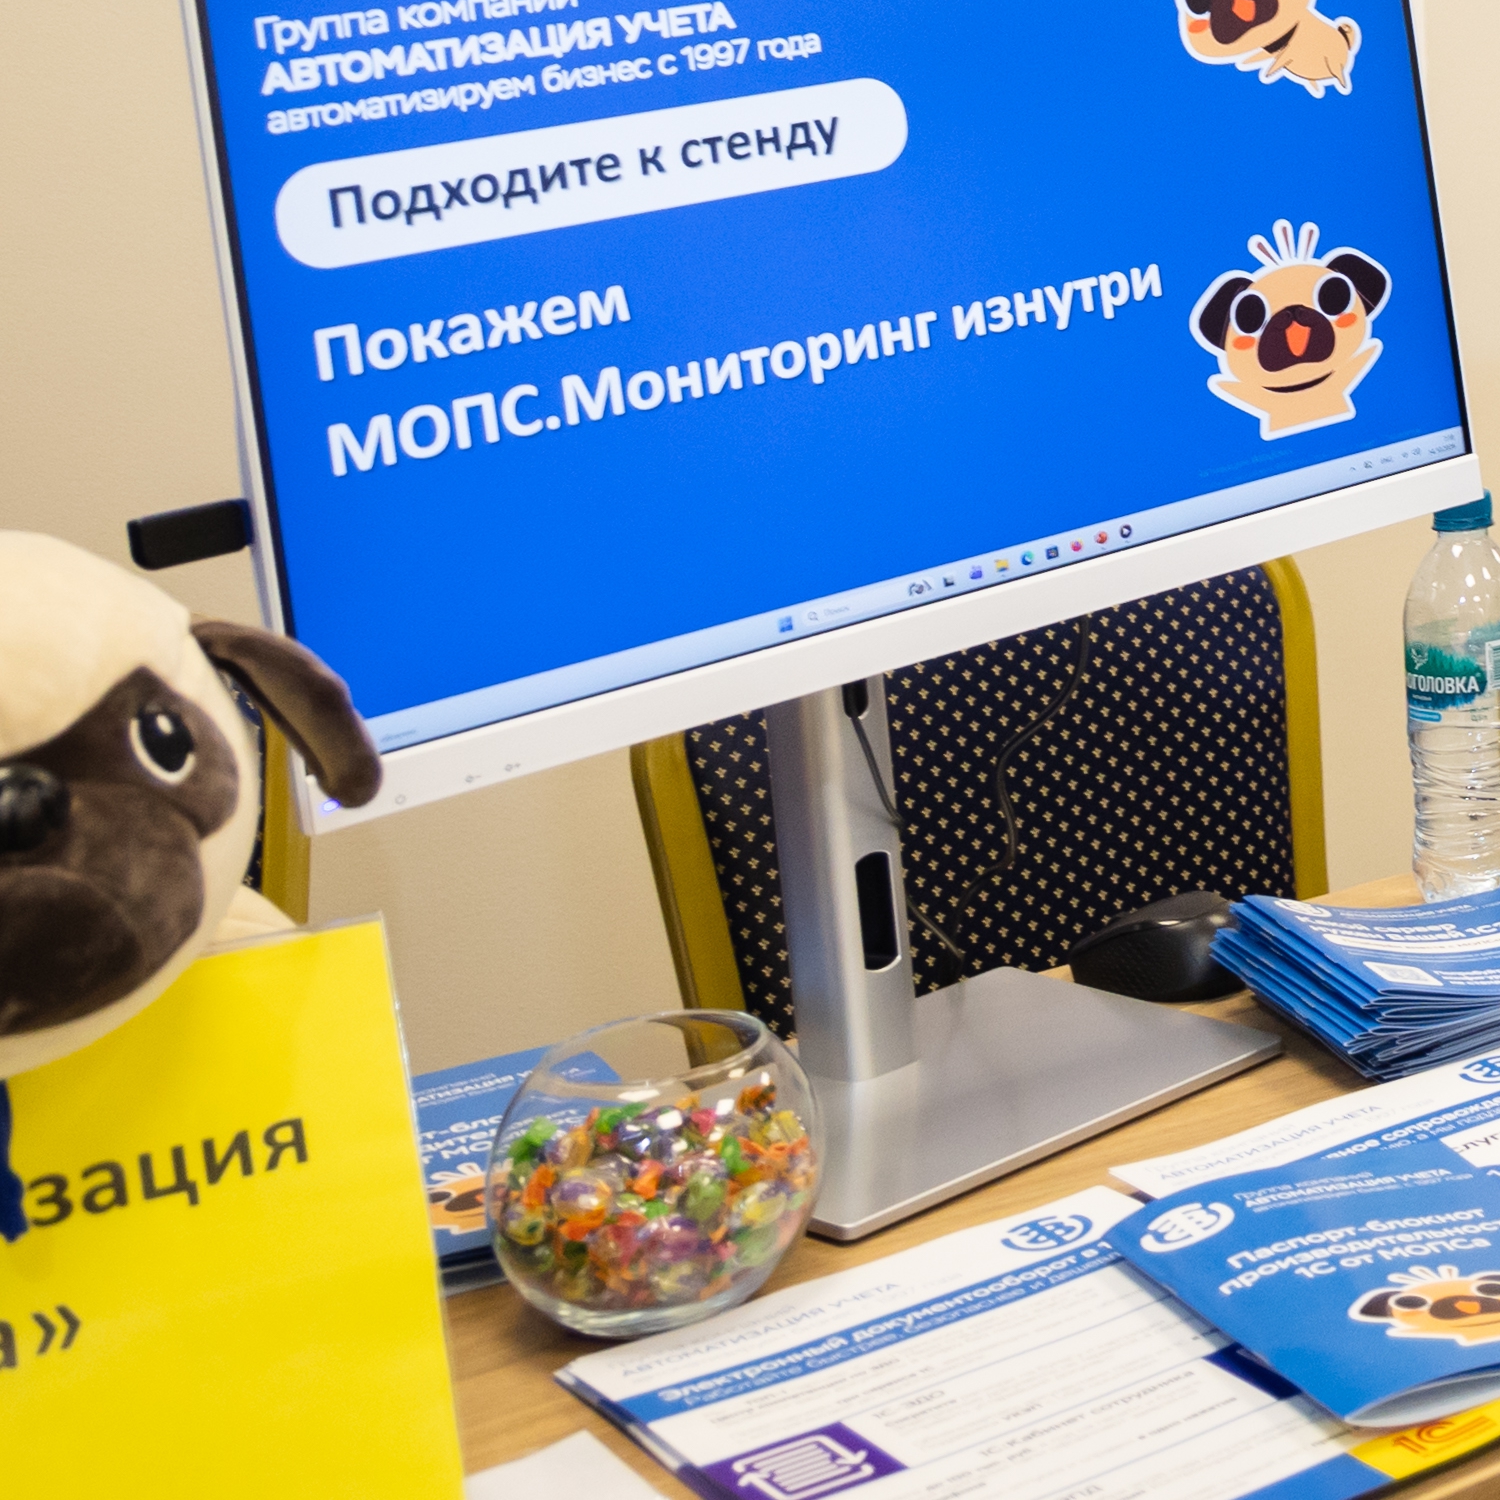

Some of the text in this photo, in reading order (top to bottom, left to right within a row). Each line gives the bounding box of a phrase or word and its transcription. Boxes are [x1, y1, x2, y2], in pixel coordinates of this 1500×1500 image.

[254, 8, 388, 52] Группа
[261, 1, 736, 95] АВТОМАТИЗАЦИЯ УЧЕТА
[266, 28, 822, 134] автоматизируем бизнес с 1997 года
[327, 116, 840, 230] Подходите к стенду
[313, 283, 631, 382] Покажем
[327, 263, 1163, 477] МОПС.Мониторинг изнутри
[26, 1116, 309, 1229] зация
[1160, 1105, 1381, 1180] АВТОМАТИЗАЦИЯ УЧЕТА
[1245, 1167, 1452, 1208] АВТОМАТИЗАЦИЯ УЧЕТА
[1227, 1207, 1486, 1270] Паспорт-блокнот
[1294, 1236, 1492, 1279] 1С от МОПСа
[622, 1305, 826, 1377] АВТОМАТИЗАЦИЯ
[657, 1334, 849, 1402] Электронный
[852, 1255, 1078, 1345] документооборот
[1393, 1415, 1497, 1455] 1С
